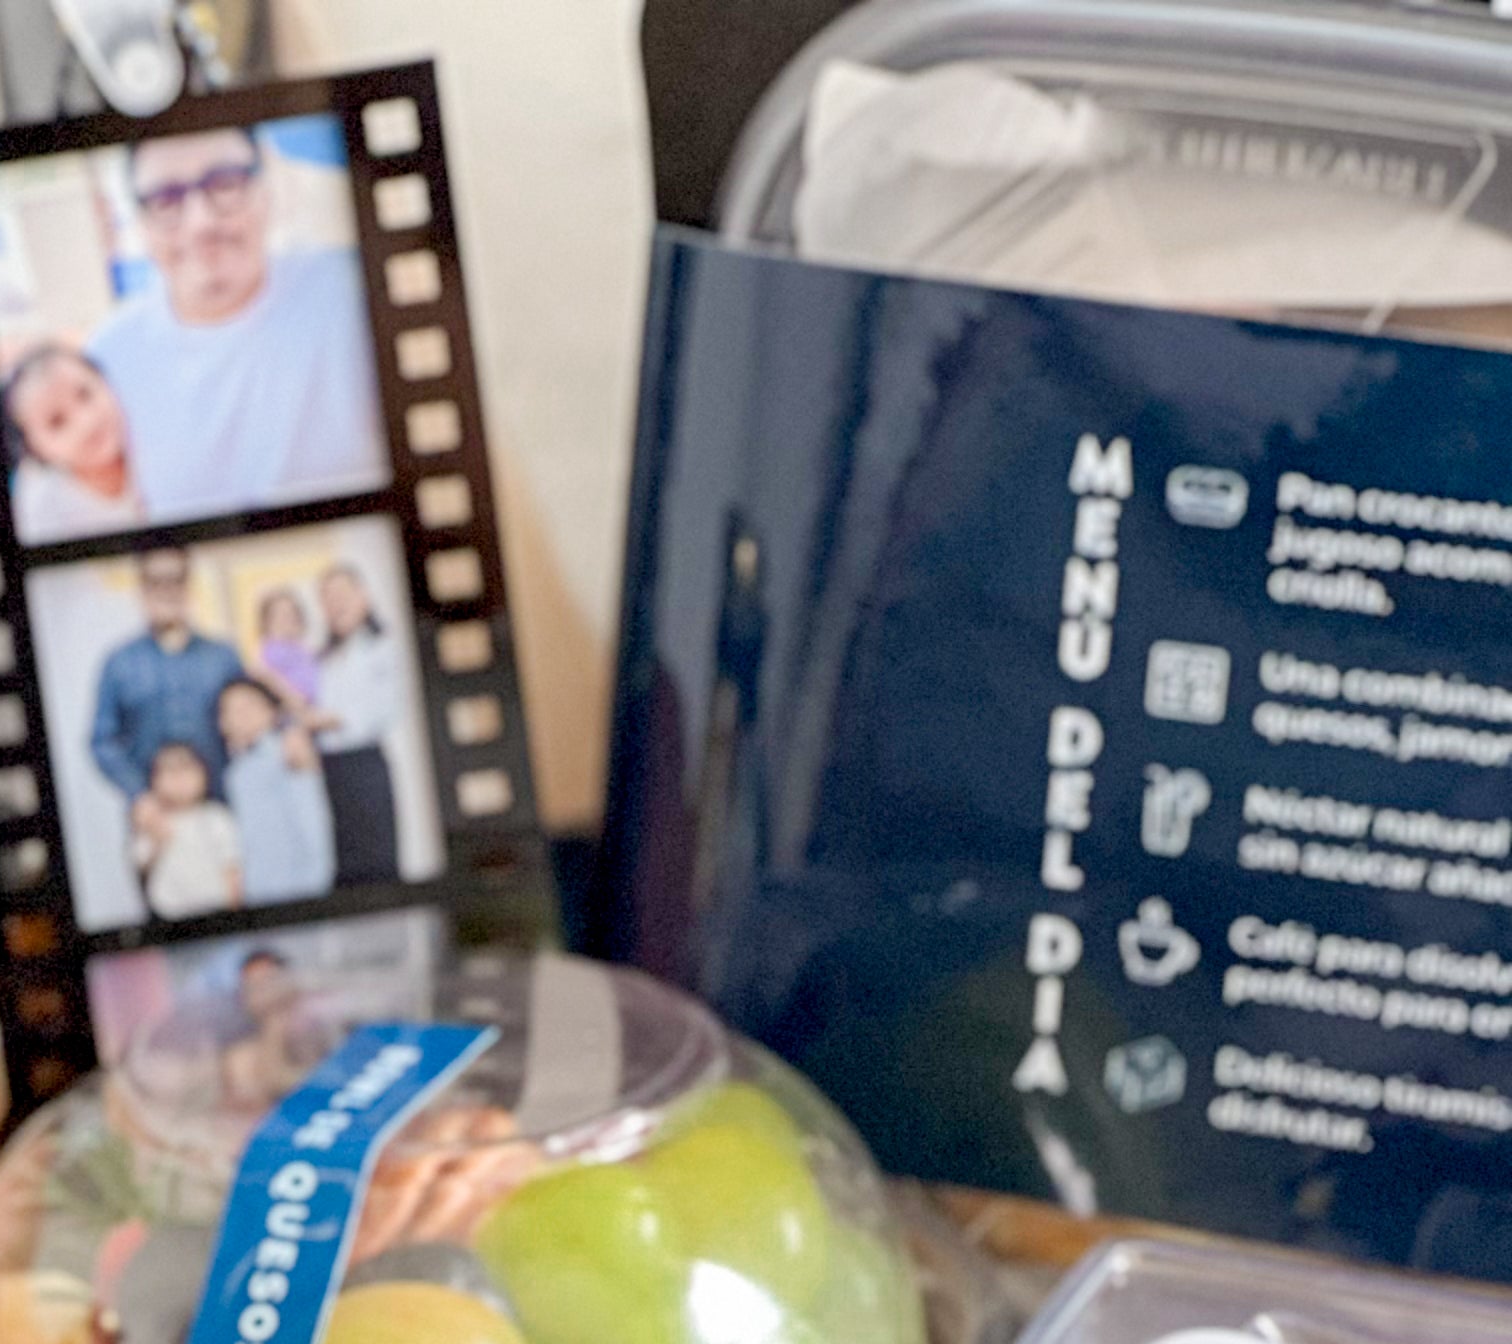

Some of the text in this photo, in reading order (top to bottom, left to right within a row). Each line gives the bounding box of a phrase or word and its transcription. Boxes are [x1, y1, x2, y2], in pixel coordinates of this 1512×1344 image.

[1278, 472, 1355, 519] Pan
[1267, 515, 1403, 569] jugoso
[1260, 651, 1341, 698] Una
[1041, 706, 1103, 890] DEL
[1245, 785, 1511, 857] Néctar natural
[1238, 830, 1299, 872] sin
[1228, 916, 1317, 963] Café
[1317, 935, 1404, 978] para
[1223, 964, 1380, 1019] perfecto
[1381, 990, 1469, 1033] para
[1214, 1046, 1382, 1108] Delicioso
